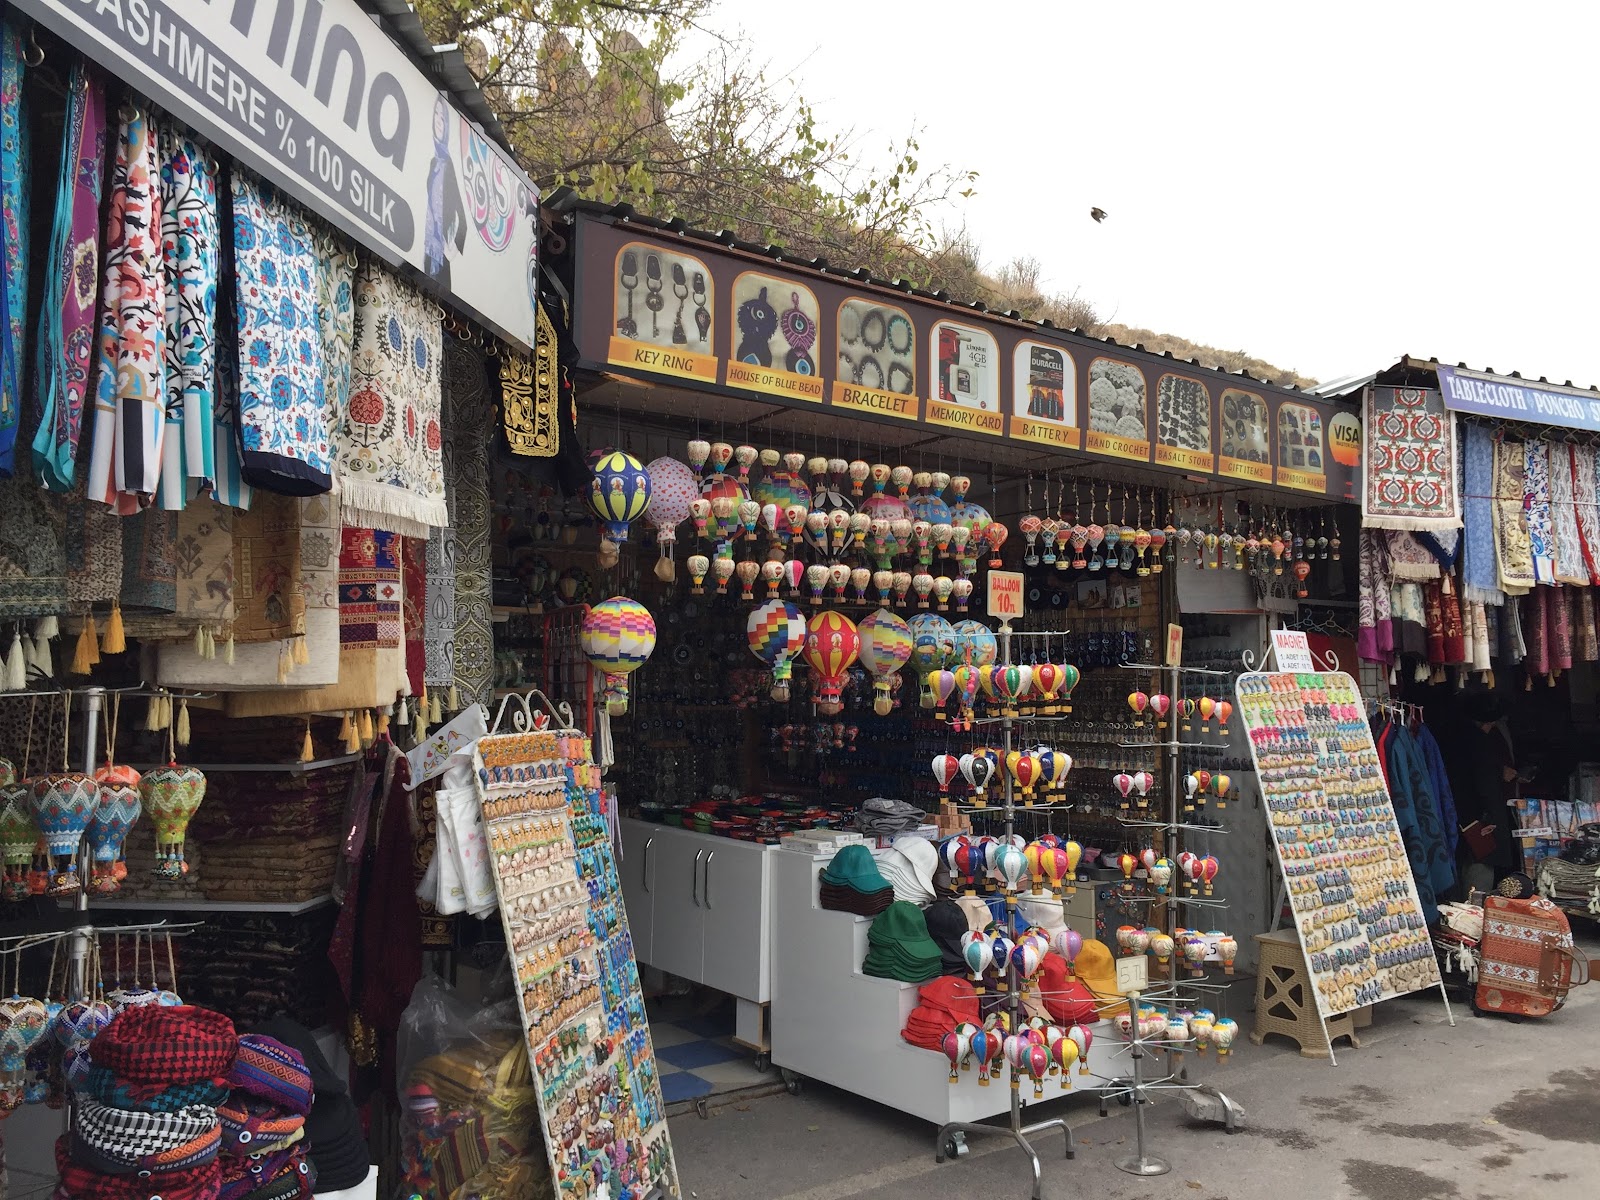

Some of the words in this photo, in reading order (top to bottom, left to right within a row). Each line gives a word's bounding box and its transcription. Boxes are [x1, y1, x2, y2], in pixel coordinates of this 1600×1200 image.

[82, 0, 266, 136] ASHMERE
[275, 109, 297, 159] %
[305, 136, 344, 192] 100
[350, 169, 396, 233] SILK
[634, 348, 660, 365] KEY
[662, 352, 694, 373] RING
[969, 352, 987, 364] 4GB
[1031, 358, 1063, 371] DURACELL
[729, 368, 760, 384] HOUSE
[761, 374, 774, 386] OF
[774, 377, 797, 391] BLUE
[798, 381, 821, 395] BEAD
[842, 388, 908, 413] BRACELET
[1447, 376, 1528, 410] TABLECLOTH
[1532, 392, 1585, 420] PONCHO
[930, 405, 975, 425] MEMORY
[975, 414, 1002, 431] CARD
[1022, 423, 1070, 442] BATTERY
[1332, 423, 1360, 444] VISA
[1087, 436, 1111, 450] HAND
[1112, 440, 1149, 456] CROCHET
[1157, 448, 1187, 463] BASALT
[1188, 455, 1211, 468] STONE
[1227, 462, 1244, 474] GIFT
[1244, 464, 1264, 477] ITEMS
[992, 577, 1020, 592] BALLOON
[1276, 634, 1306, 649] MAGNET
